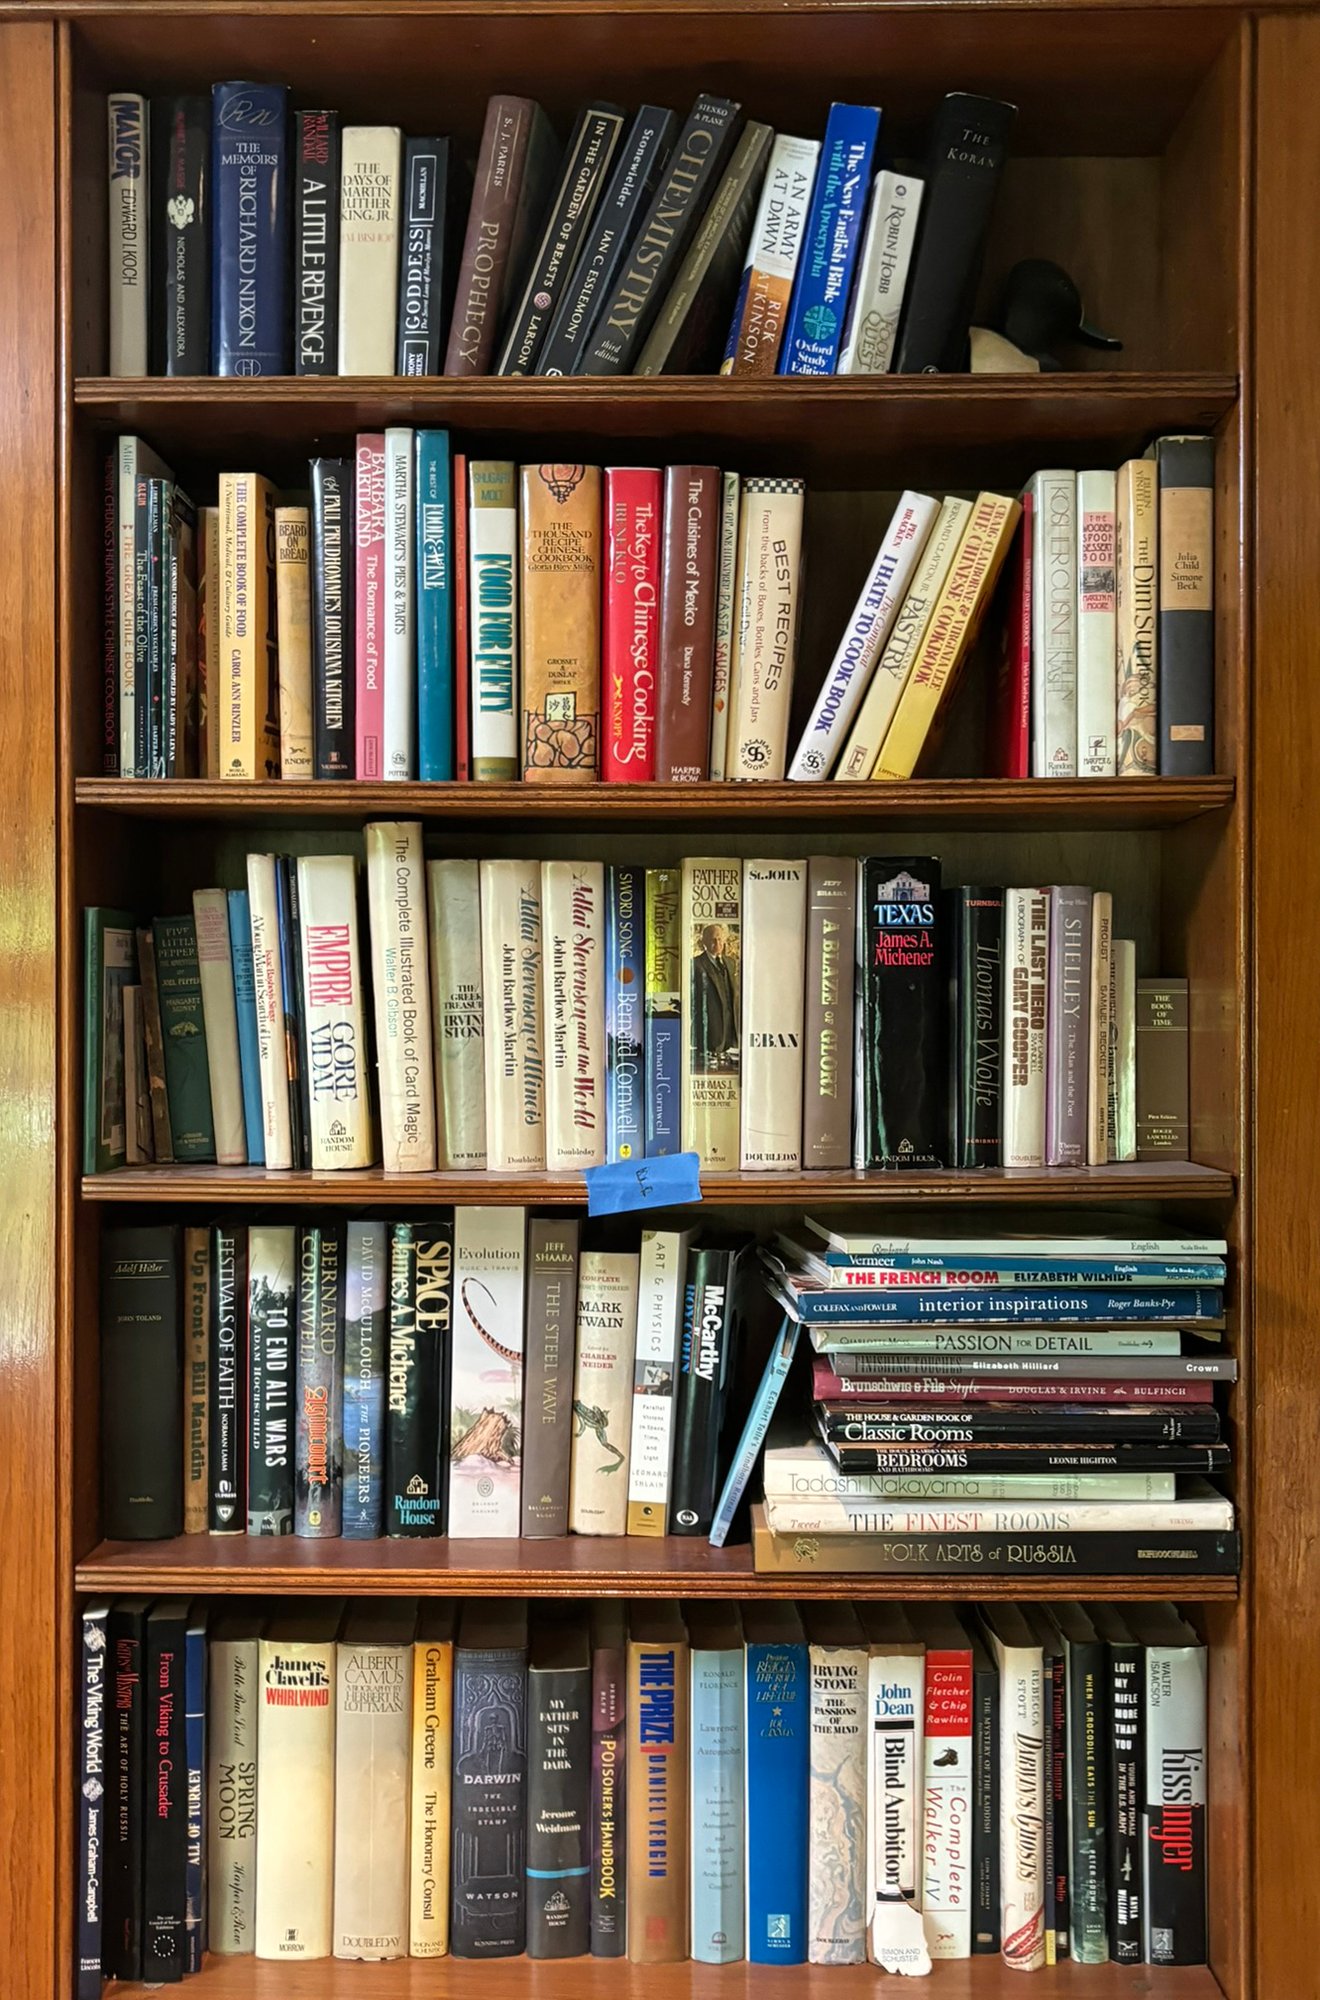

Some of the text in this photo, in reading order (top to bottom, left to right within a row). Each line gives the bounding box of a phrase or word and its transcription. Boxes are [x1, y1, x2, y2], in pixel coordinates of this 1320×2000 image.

[962, 130, 990, 146] THE
[236, 142, 260, 153] THE
[221, 154, 278, 165] MEMOIRS
[947, 148, 996, 168] KORAN
[241, 166, 257, 176] OF
[616, 129, 654, 208] Stonewielder
[792, 171, 808, 200] AN
[544, 120, 607, 287] IN THE GARDEN OF BEASTS
[762, 169, 790, 254] AT DAWN
[607, 129, 713, 341] CHEMISTRY
[780, 208, 800, 260] ARMY
[239, 177, 257, 348] RICHARD NIXON
[300, 178, 325, 365] A LITTLE REVENGE
[406, 228, 424, 330] GODDESS
[458, 222, 499, 367] PROPHECY
[743, 272, 770, 363] ATKINSON
[762, 300, 782, 342] RICK
[518, 316, 542, 365] LARSON
[279, 524, 307, 536] BEARD
[287, 538, 298, 547] ON
[538, 546, 584, 554] CHINESE
[235, 481, 247, 638] THE COMPLETE BOOK OF FOOD
[280, 548, 307, 560] BREAD
[532, 554, 594, 562] COOKBOOK
[685, 479, 703, 626] The Cuisines of Mexico
[1177, 552, 1198, 561] Julia
[1175, 561, 1199, 569] Child
[1171, 573, 1203, 582] Simone
[1177, 582, 1199, 591] Beck
[765, 540, 791, 690] BEST RECIPES
[814, 554, 899, 734] I HATE TO COOK BOOK
[692, 869, 738, 885] FATHER
[873, 904, 933, 926] TEXAS
[876, 930, 933, 948] James A.
[874, 948, 933, 966] Michener
[306, 924, 353, 1009] EMPIRE
[1063, 918, 1082, 1025] SHELLEY
[395, 837, 420, 1144] The Complete Illustrated Book of Card Magic
[975, 940, 1001, 1107] Thomas Wolfe
[750, 1033, 799, 1049] EBAN
[311, 1020, 336, 1101] VIDAL
[332, 1022, 358, 1100] GORE
[459, 1247, 520, 1260] Evolution
[545, 1243, 565, 1251] JEFF
[535, 1253, 574, 1262] SHAARA
[850, 1256, 895, 1267] Vermeer
[416, 1241, 451, 1332] SPACE
[846, 1272, 999, 1285] THE FRENCH ROOM
[1014, 1273, 1132, 1282] ELIZABETH WILHIDE
[321, 1241, 337, 1356] BERNARD
[579, 1302, 621, 1313] MARK
[919, 1296, 1088, 1314] interior inspirations
[1108, 1299, 1175, 1308] Roger Banks-Pye
[219, 1238, 235, 1409] FESTIVALS OF FAITH
[577, 1317, 624, 1329] TWAIN
[935, 1336, 1011, 1350] PASSION
[1036, 1337, 1093, 1350] DETAIL
[1186, 1364, 1219, 1372] Crown
[265, 1307, 288, 1467] TO END ALL WARS
[845, 1423, 973, 1441] Classic Rooms
[877, 1454, 968, 1467] BEDROOMS
[788, 1473, 979, 1496] Tadashi Nakayama
[395, 1495, 440, 1510] Random
[400, 1511, 435, 1525] House
[849, 1513, 1070, 1531] THE FINEST ROOMS
[270, 1656, 326, 1672] James
[347, 1656, 402, 1670] ALBERT
[813, 1665, 858, 1677] IRVING
[265, 1671, 330, 1686] Clavell's
[345, 1670, 404, 1683] CAMUS
[814, 1678, 857, 1690] STONE
[1151, 1661, 1160, 1707] ISAACSON
[1162, 1661, 1171, 1696] WALTER
[266, 1688, 329, 1706] WHIRLWIND
[877, 1684, 911, 1699] John
[84, 1654, 103, 1774] The Viking World
[425, 1648, 440, 1769] Graham Greene
[875, 1700, 914, 1715] Dean
[155, 1652, 174, 1819] From Viking to Crusader
[464, 1774, 522, 1784] DARWIN
[219, 1764, 235, 1840] MOON
[238, 1762, 256, 1840] SPRING
[1148, 1748, 1203, 1870] Kissinger
[648, 1755, 666, 1877] DANIEL YERGIN
[884, 1737, 905, 1885] Blind Ambition
[421, 1792, 437, 1920] The Honorary Consul
